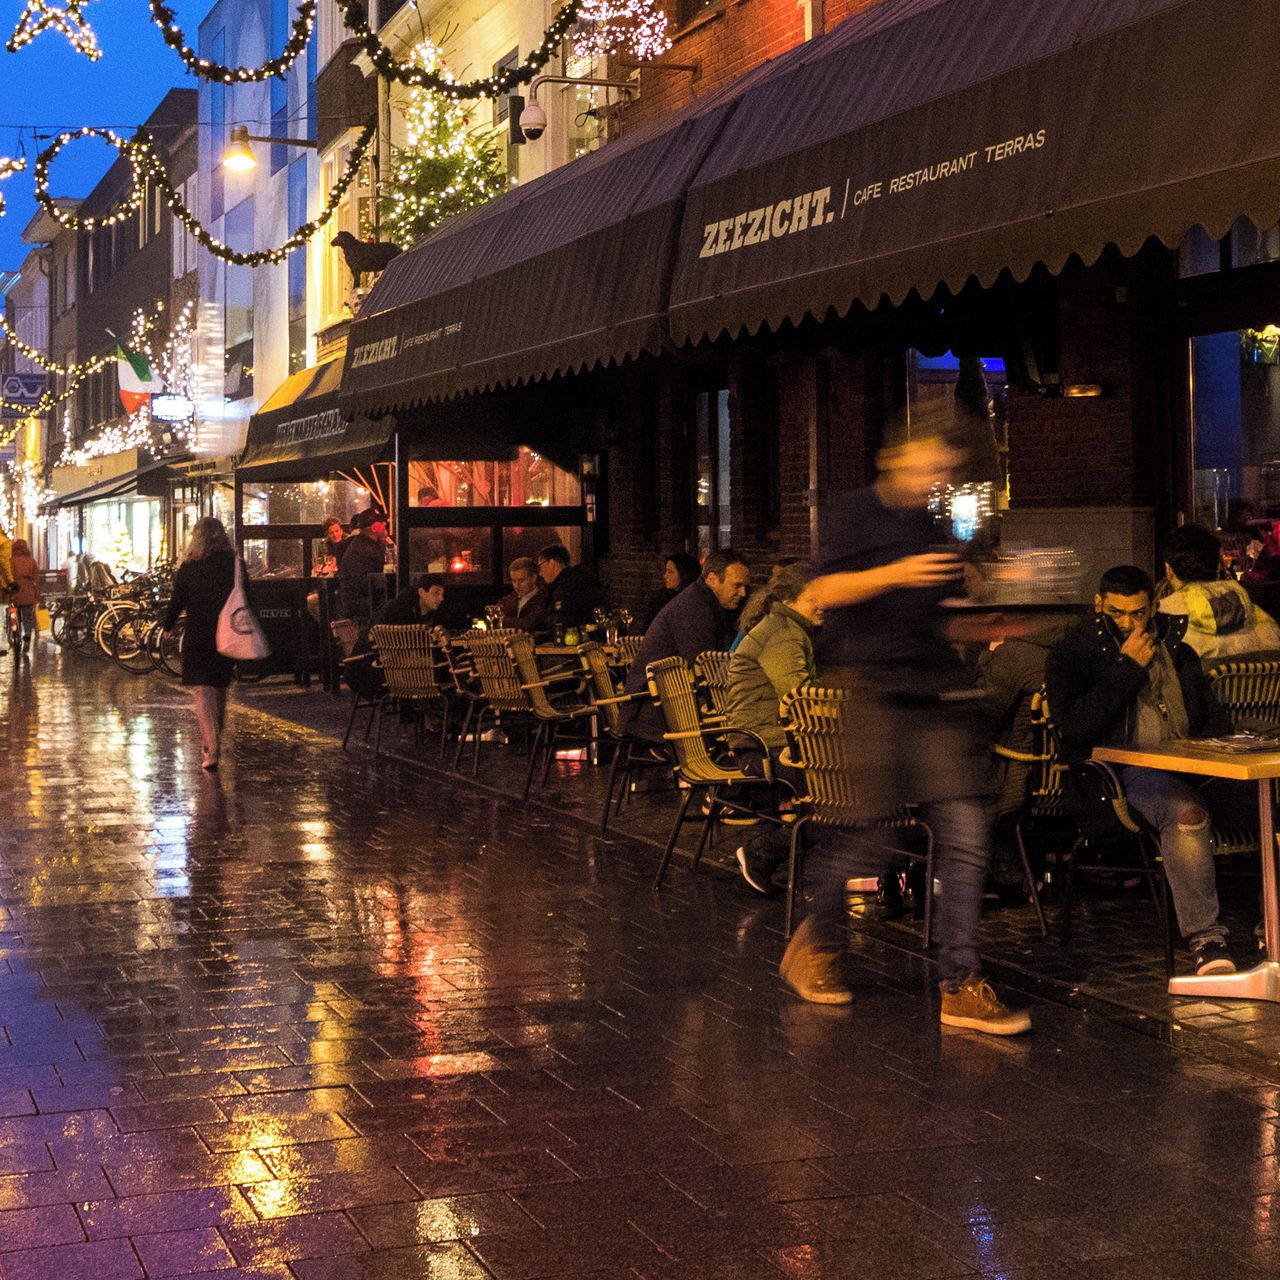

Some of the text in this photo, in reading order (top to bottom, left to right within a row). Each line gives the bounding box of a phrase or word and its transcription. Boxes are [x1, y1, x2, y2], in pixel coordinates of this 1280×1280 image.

[853, 182, 882, 207] CAFE
[889, 151, 977, 195] RESTAURANT
[985, 129, 1046, 164] TERRAS
